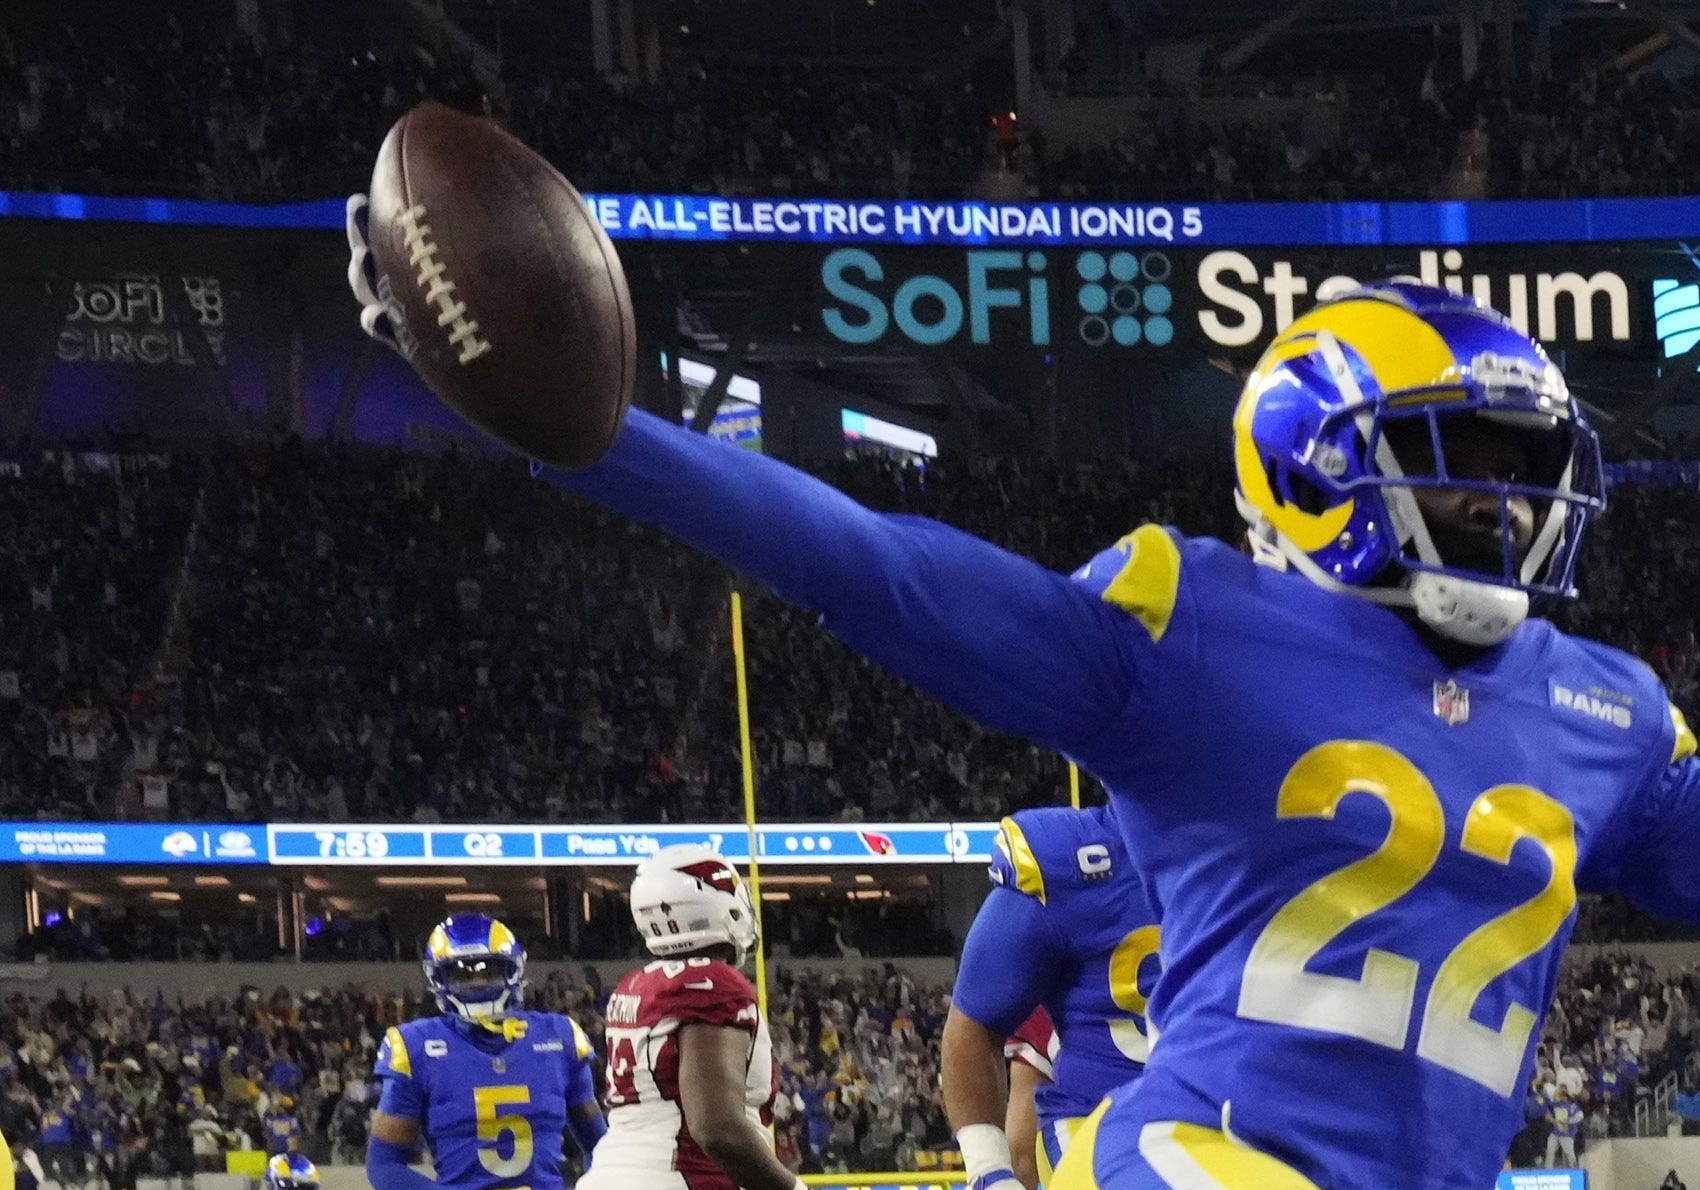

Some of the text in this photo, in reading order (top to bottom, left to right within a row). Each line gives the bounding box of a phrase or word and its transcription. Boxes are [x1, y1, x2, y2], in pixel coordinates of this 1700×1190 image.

[629, 200, 885, 234] ALL-ELECTRIC
[894, 205, 1061, 237] HYUNDAI
[1071, 207, 1174, 242] IONIQ
[1182, 208, 1203, 237] 5
[822, 249, 1050, 345] SoFi
[1554, 685, 1632, 730] RAMS
[315, 831, 388, 858] 7:59
[463, 832, 504, 858] Q2
[944, 829, 970, 857] 0
[1076, 844, 1112, 875] C
[1236, 738, 1578, 1099] 22
[474, 1084, 534, 1178] 5
